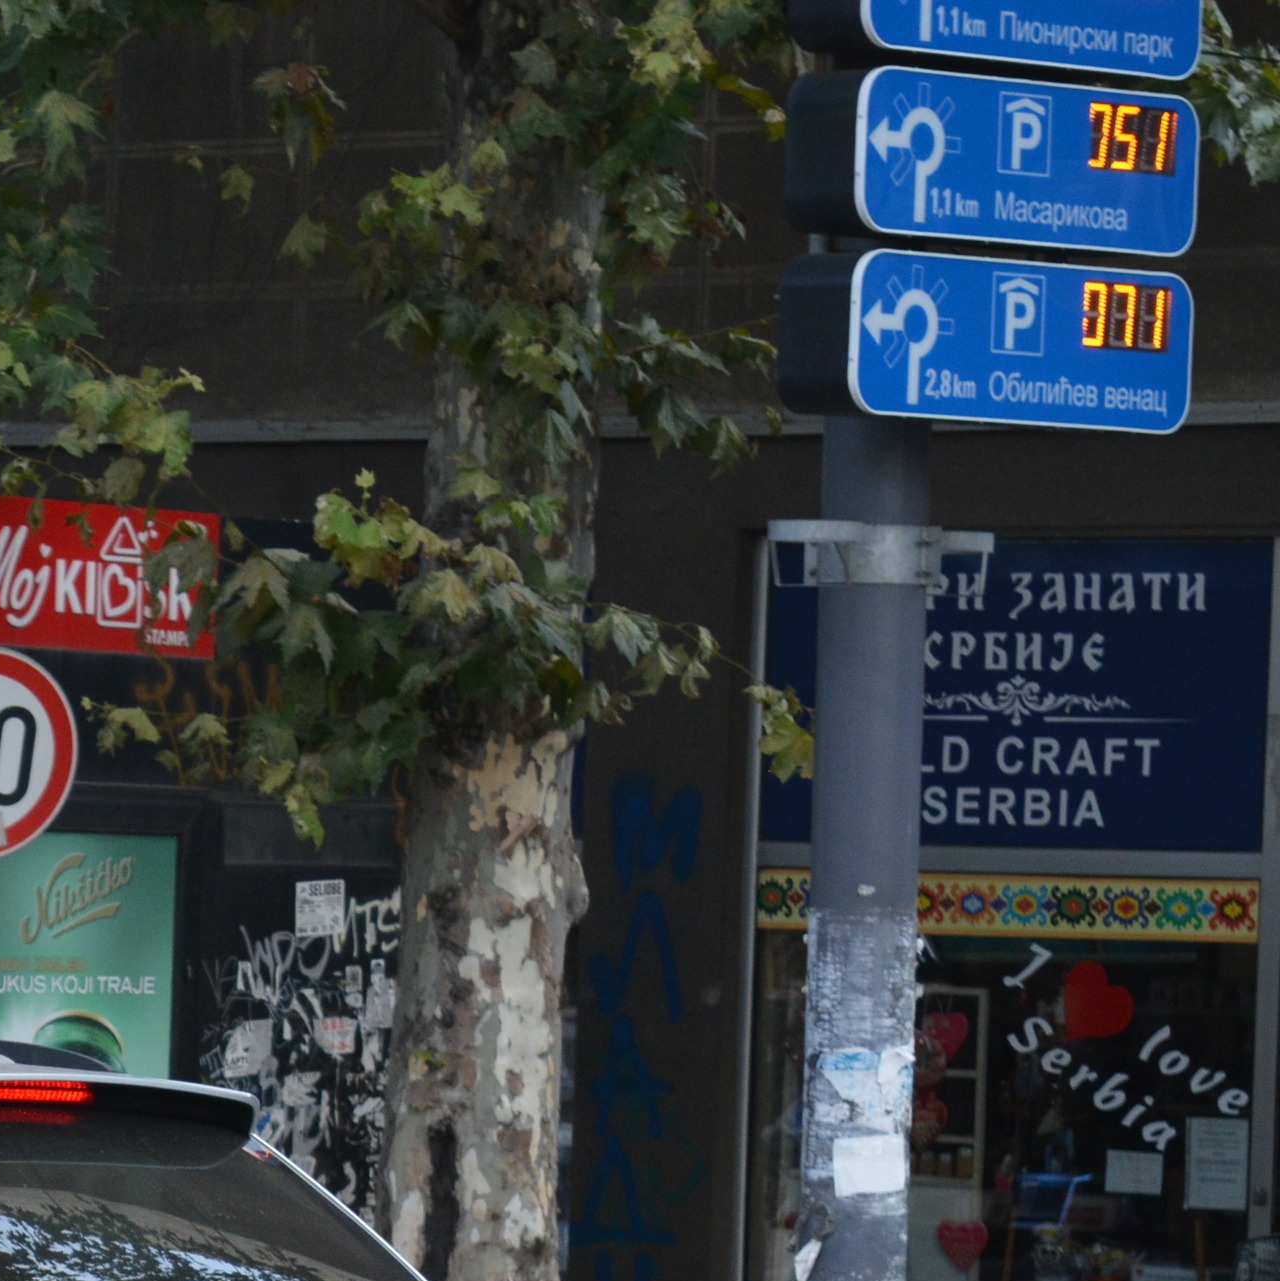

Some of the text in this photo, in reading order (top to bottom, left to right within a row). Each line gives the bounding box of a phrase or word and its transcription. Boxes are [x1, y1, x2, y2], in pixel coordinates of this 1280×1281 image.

[962, 11, 987, 37] km
[1000, 10, 1174, 64] Пионирски парк
[930, 187, 980, 219] 1,1 km
[994, 191, 1128, 232] Масарикова
[925, 369, 976, 399] 2,8 km
[989, 371, 1168, 416] Обилићев венац
[1008, 572, 1207, 620] ЗАНАТИ
[924, 631, 1106, 671] СРБИЈЕ
[996, 735, 1161, 777] CRAFT
[922, 785, 1106, 828] SERBIA
[51, 975, 93, 994] KOJI
[97, 976, 156, 995] TRAJE
[1007, 1016, 1178, 1151] Serbia
[1139, 1025, 1250, 1116] love
